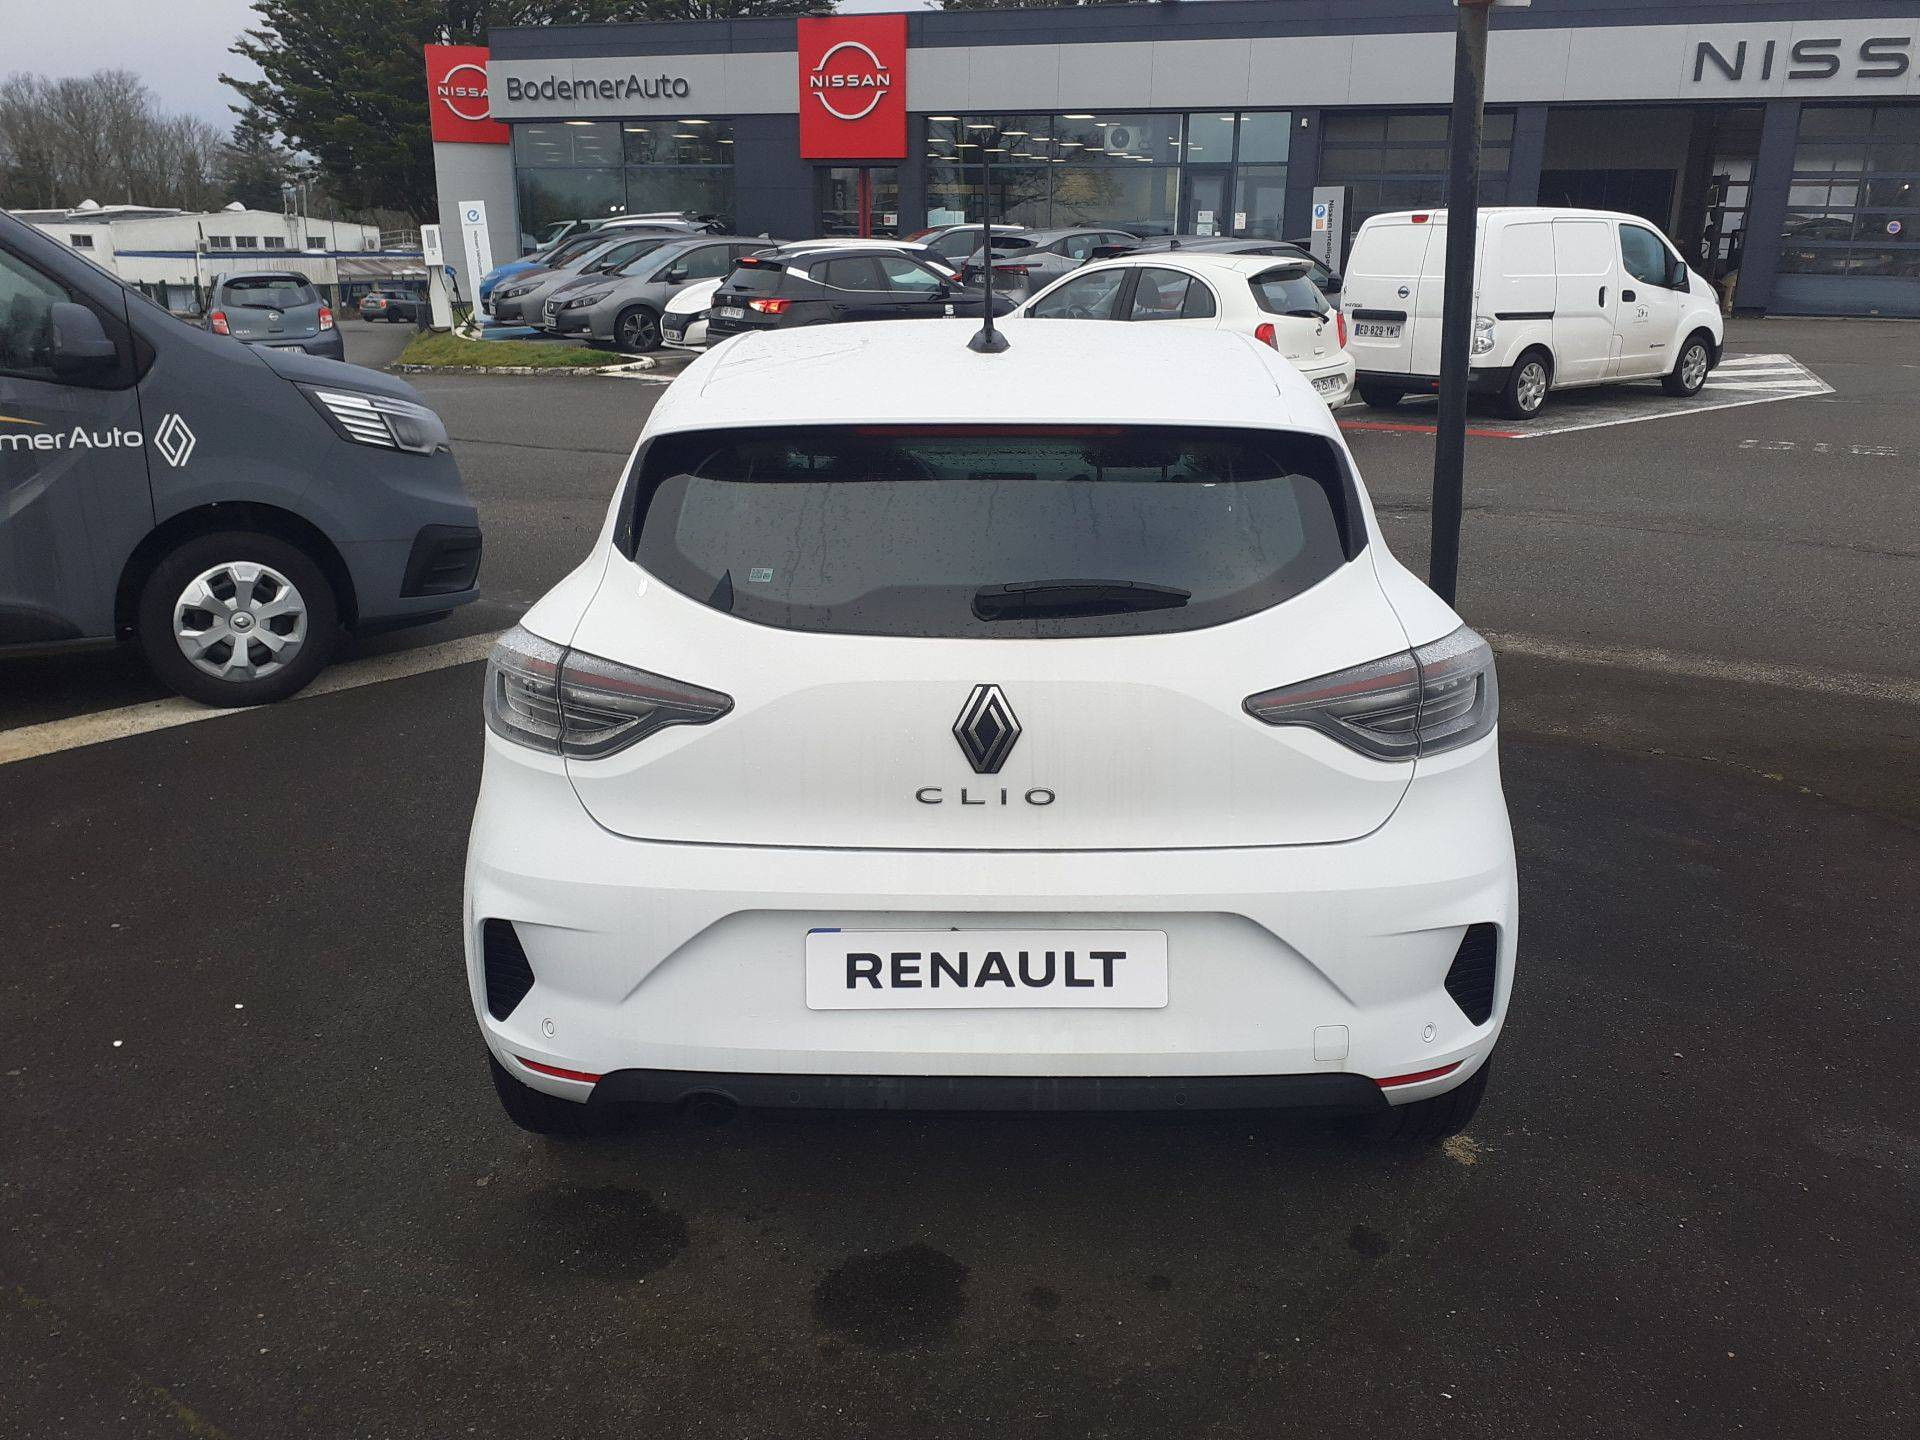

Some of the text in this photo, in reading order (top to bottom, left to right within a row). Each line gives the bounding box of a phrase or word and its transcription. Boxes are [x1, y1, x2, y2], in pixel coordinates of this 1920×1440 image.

[1693, 37, 1920, 82] NISS
[506, 74, 691, 101] BodemerAuto
[810, 73, 890, 88] NISSAN
[1327, 200, 1335, 226] Nissan
[0, 426, 143, 451] merAuto
[915, 786, 1056, 806] CLIO
[846, 951, 1127, 989] RENAULT
